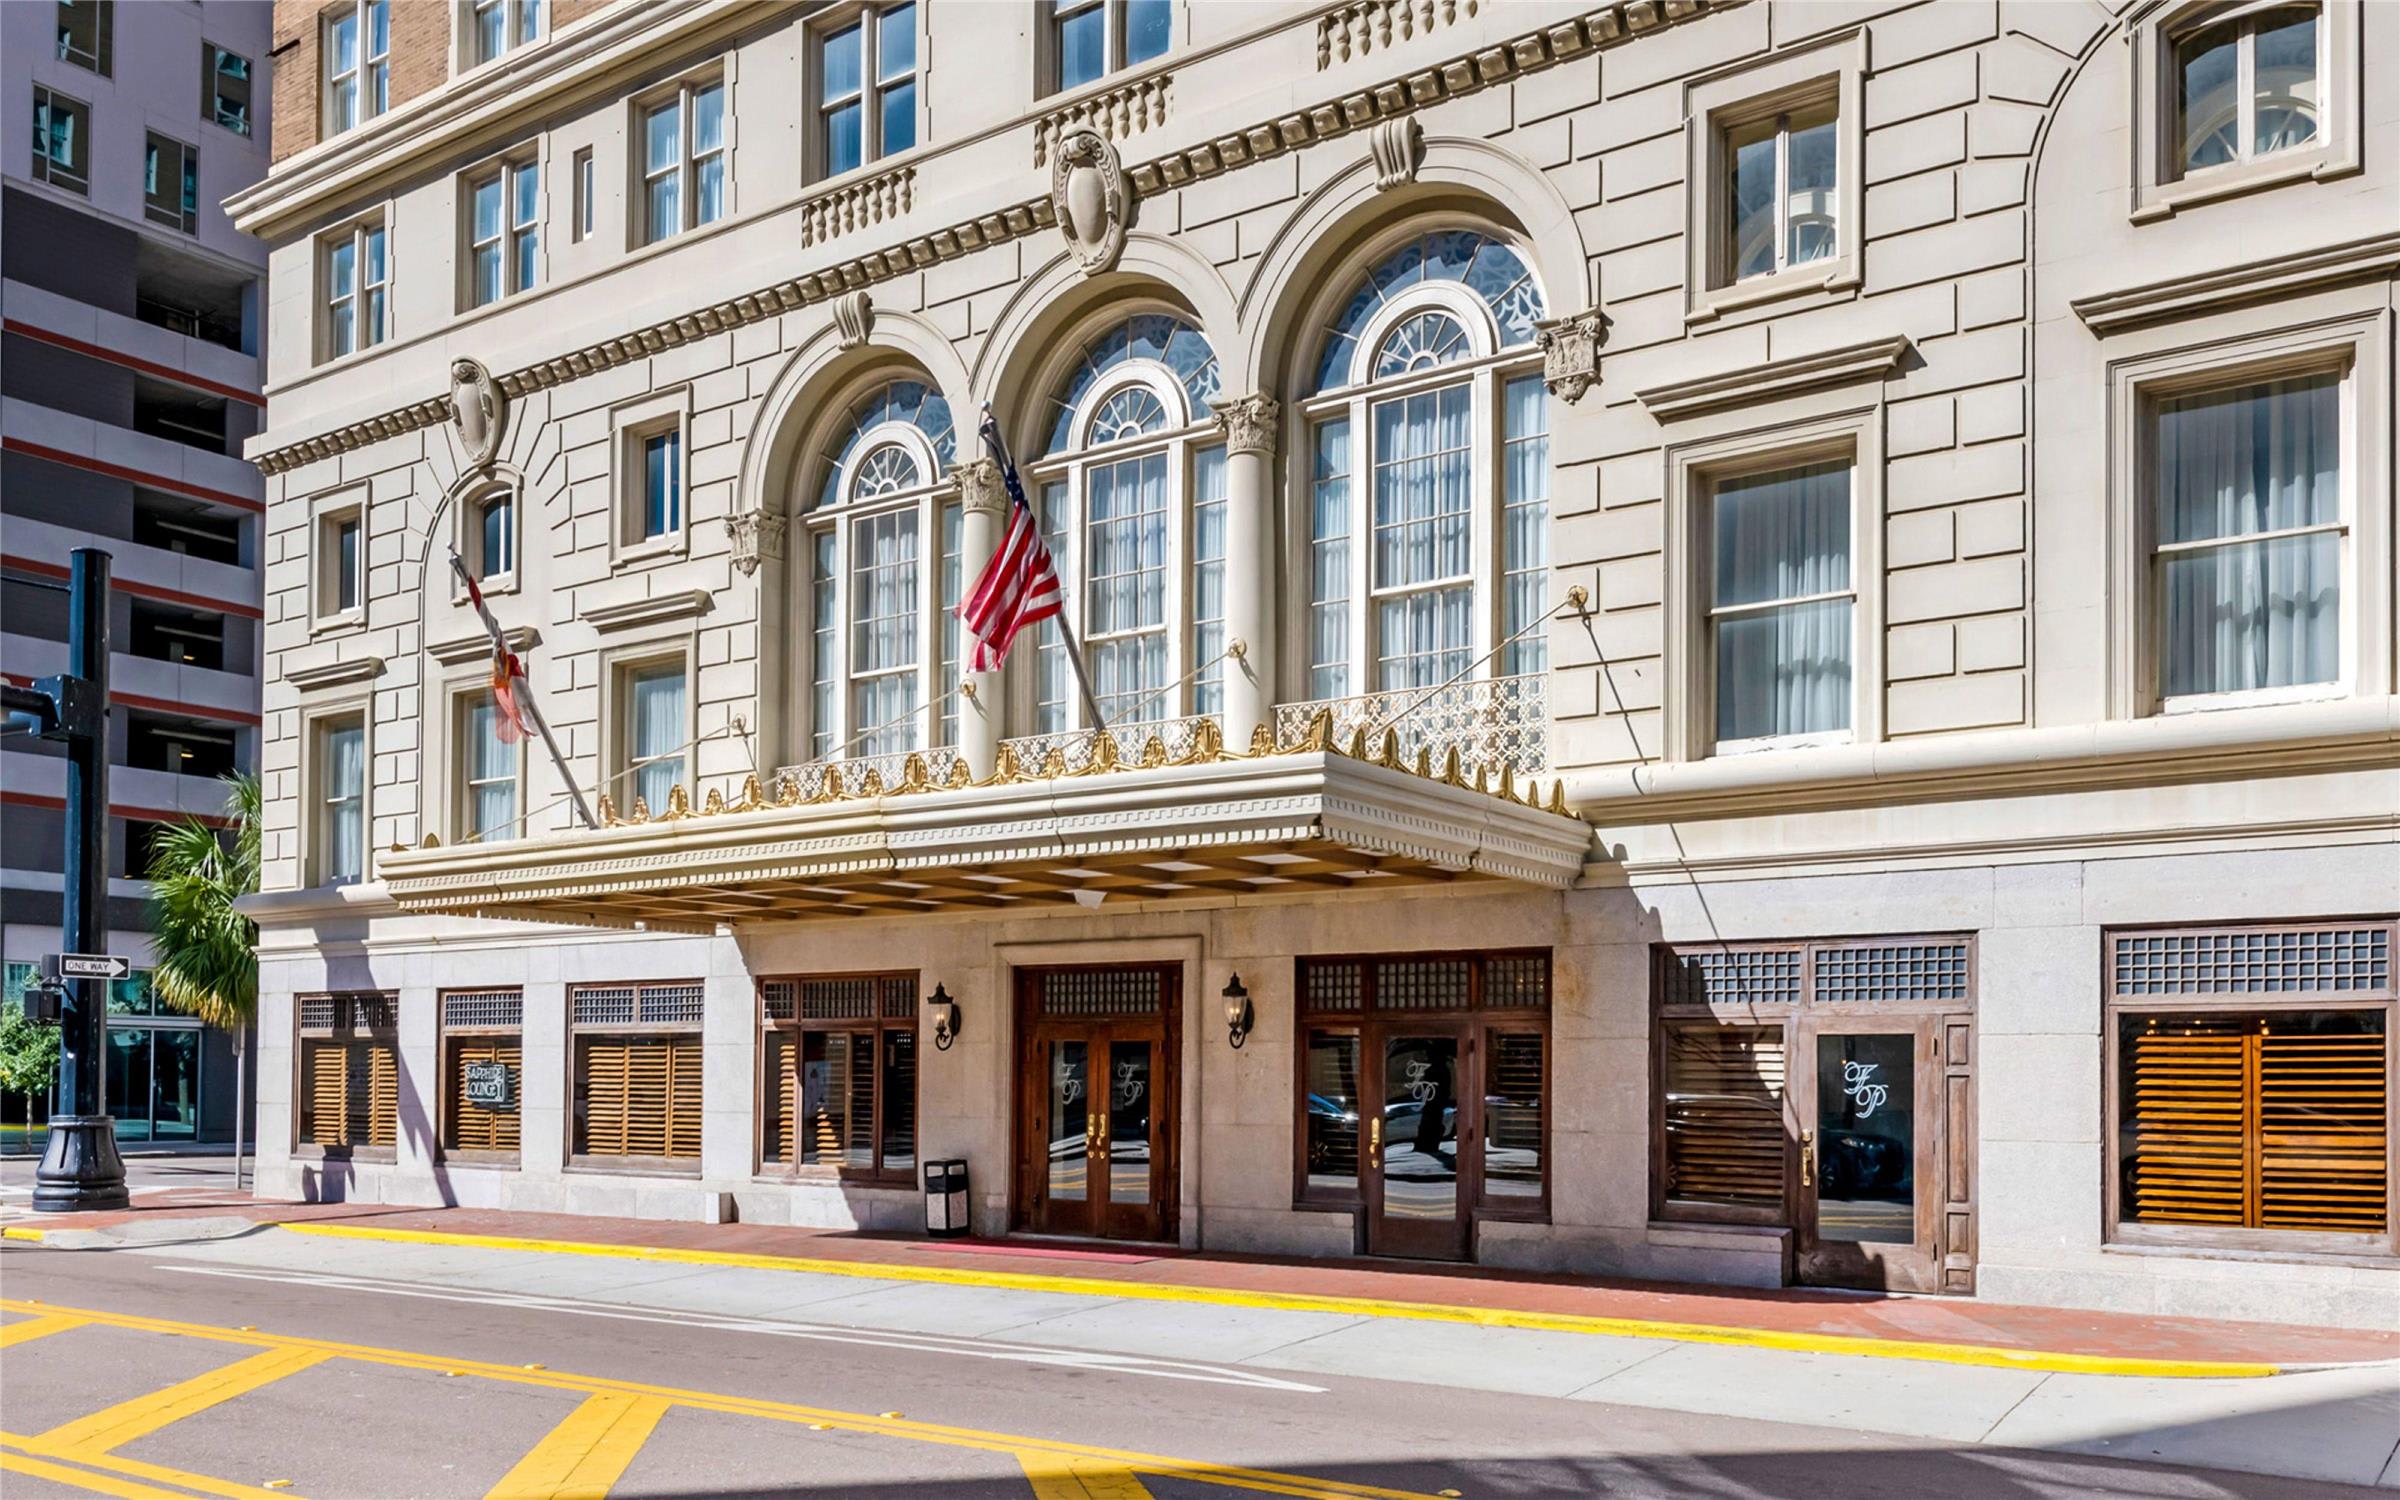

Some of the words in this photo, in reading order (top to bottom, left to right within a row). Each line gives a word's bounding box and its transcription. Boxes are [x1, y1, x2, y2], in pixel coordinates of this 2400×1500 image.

[67, 961, 87, 970] ONE
[90, 962, 109, 971] WAY
[466, 1081, 497, 1096] LOUNGE
